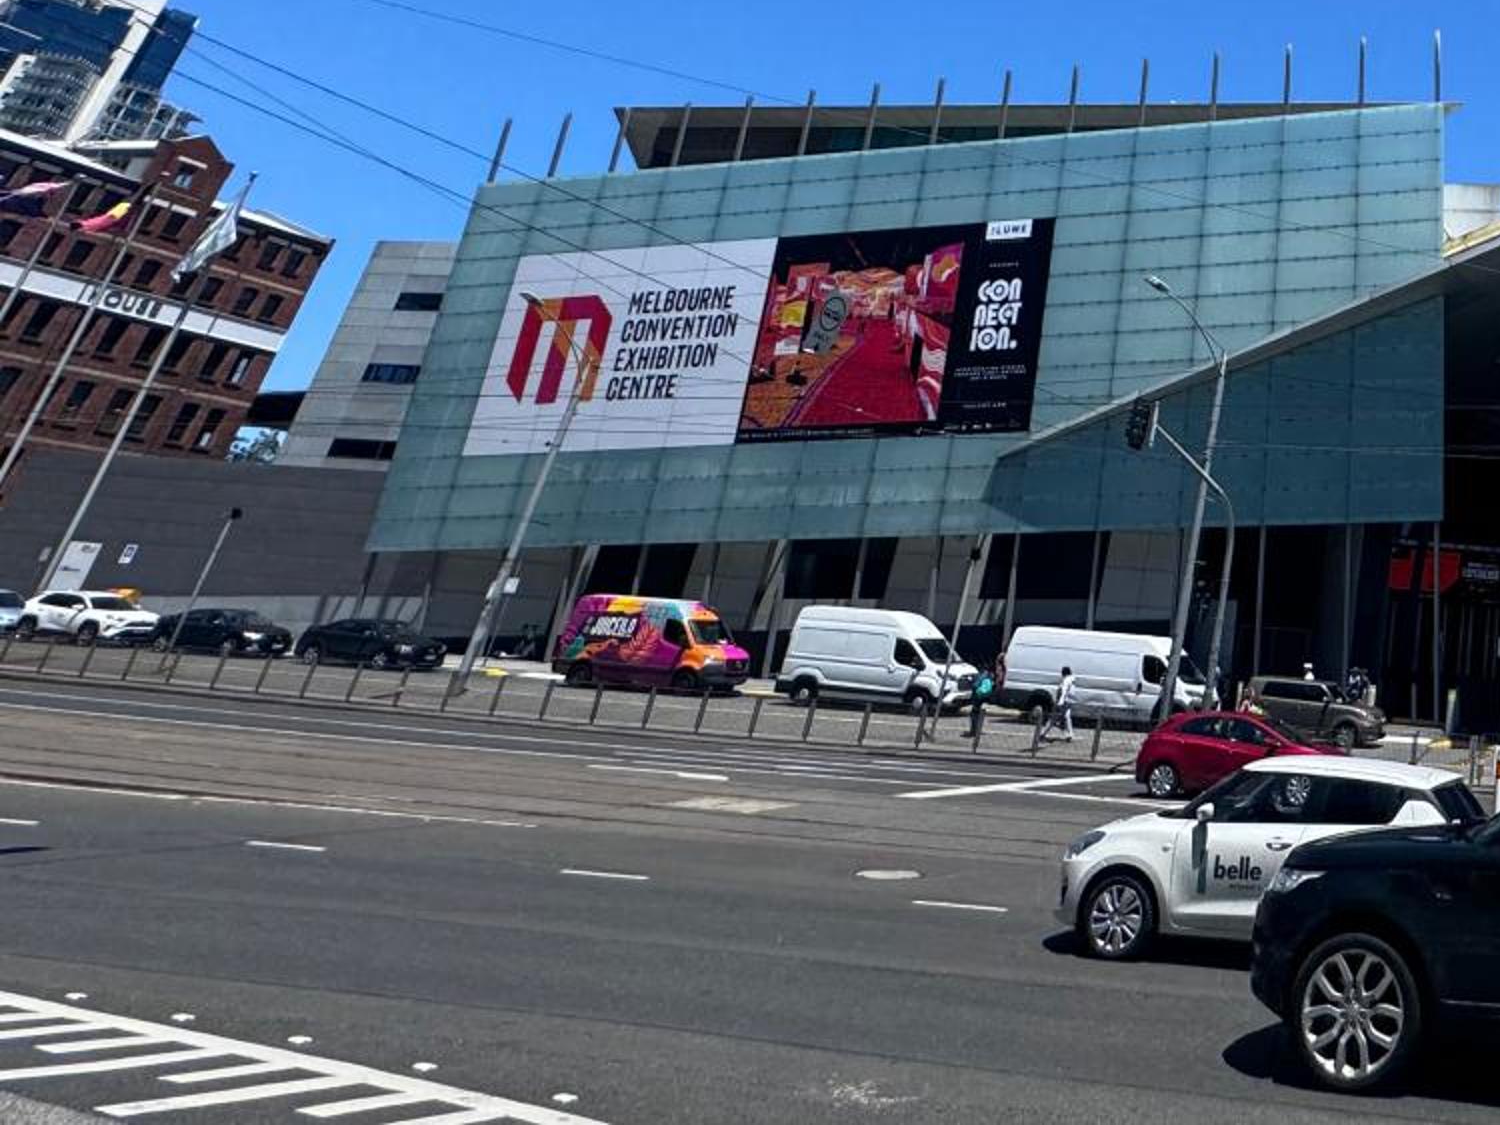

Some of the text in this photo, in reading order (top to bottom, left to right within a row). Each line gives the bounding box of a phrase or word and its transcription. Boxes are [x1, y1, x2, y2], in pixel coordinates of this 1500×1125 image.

[627, 285, 737, 315] MELBOURNE
[621, 312, 739, 343] CONVENTION
[613, 342, 719, 372] EXHIBITION
[605, 374, 678, 401] CENTRE
[1214, 854, 1262, 881] belle
